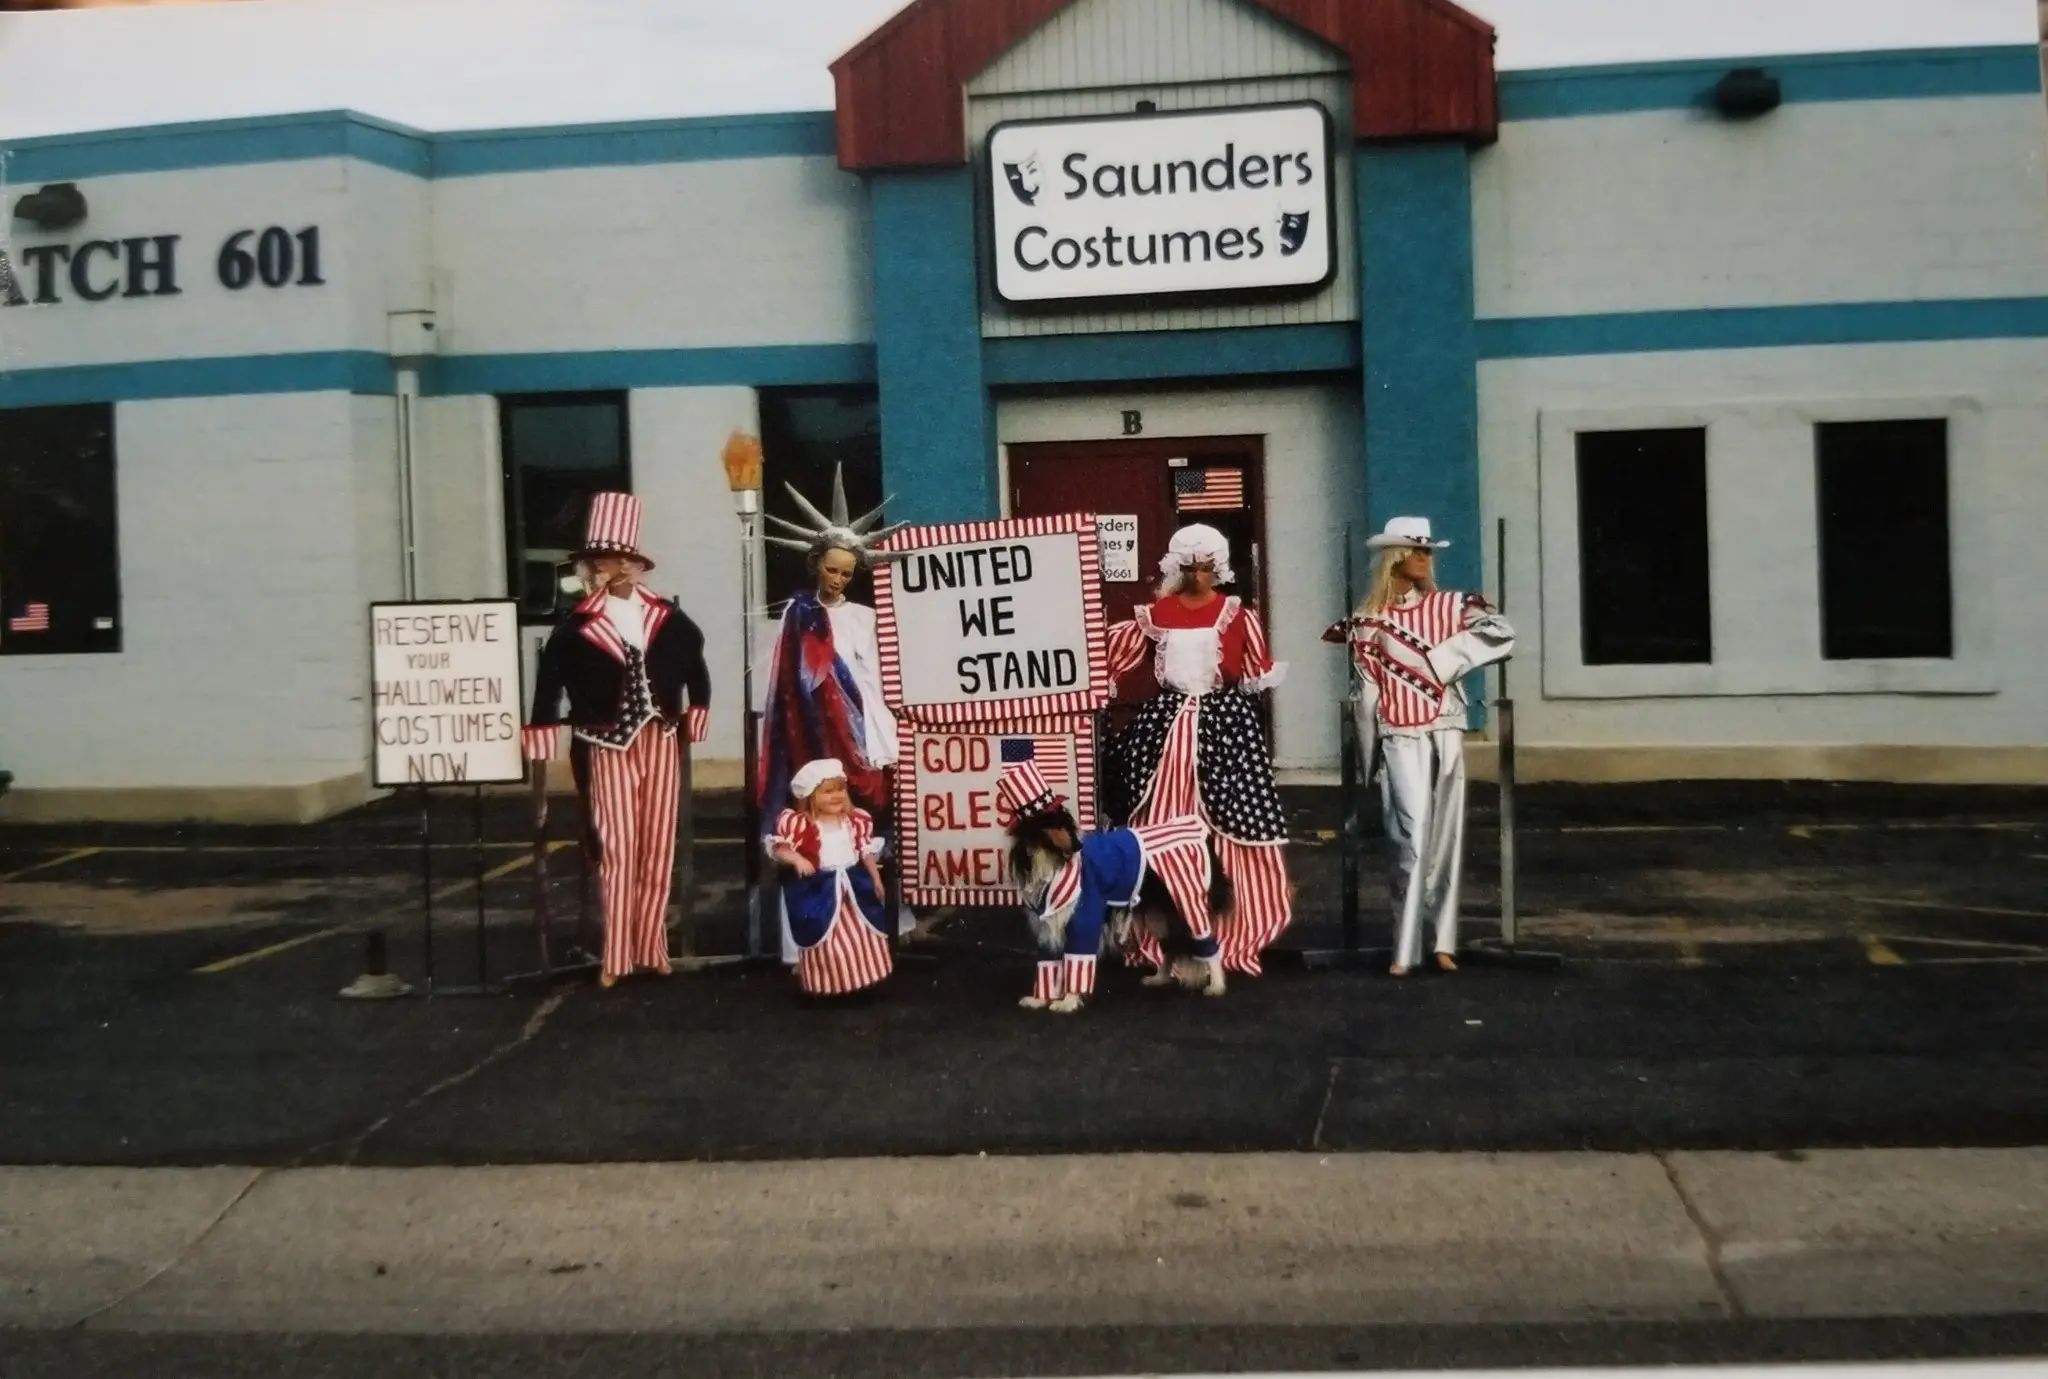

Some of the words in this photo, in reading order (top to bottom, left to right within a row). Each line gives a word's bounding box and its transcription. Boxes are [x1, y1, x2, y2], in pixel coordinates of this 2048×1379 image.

[1062, 143, 1313, 200] Saunders
[217, 225, 327, 291] 601
[1013, 225, 1265, 272] Costumes
[1120, 410, 1143, 436] B
[900, 545, 1033, 593] UNITED
[377, 613, 500, 646] RESERVE
[958, 595, 1015, 638] WE
[406, 652, 451, 670] YOUR
[956, 648, 1078, 694] STAND
[373, 677, 502, 706] HALLOWEEN
[377, 712, 514, 746] COSTUMES
[407, 752, 469, 782] NOW
[922, 736, 990, 773] GOD
[923, 790, 1018, 832] BLES
[922, 848, 1004, 887] AME
